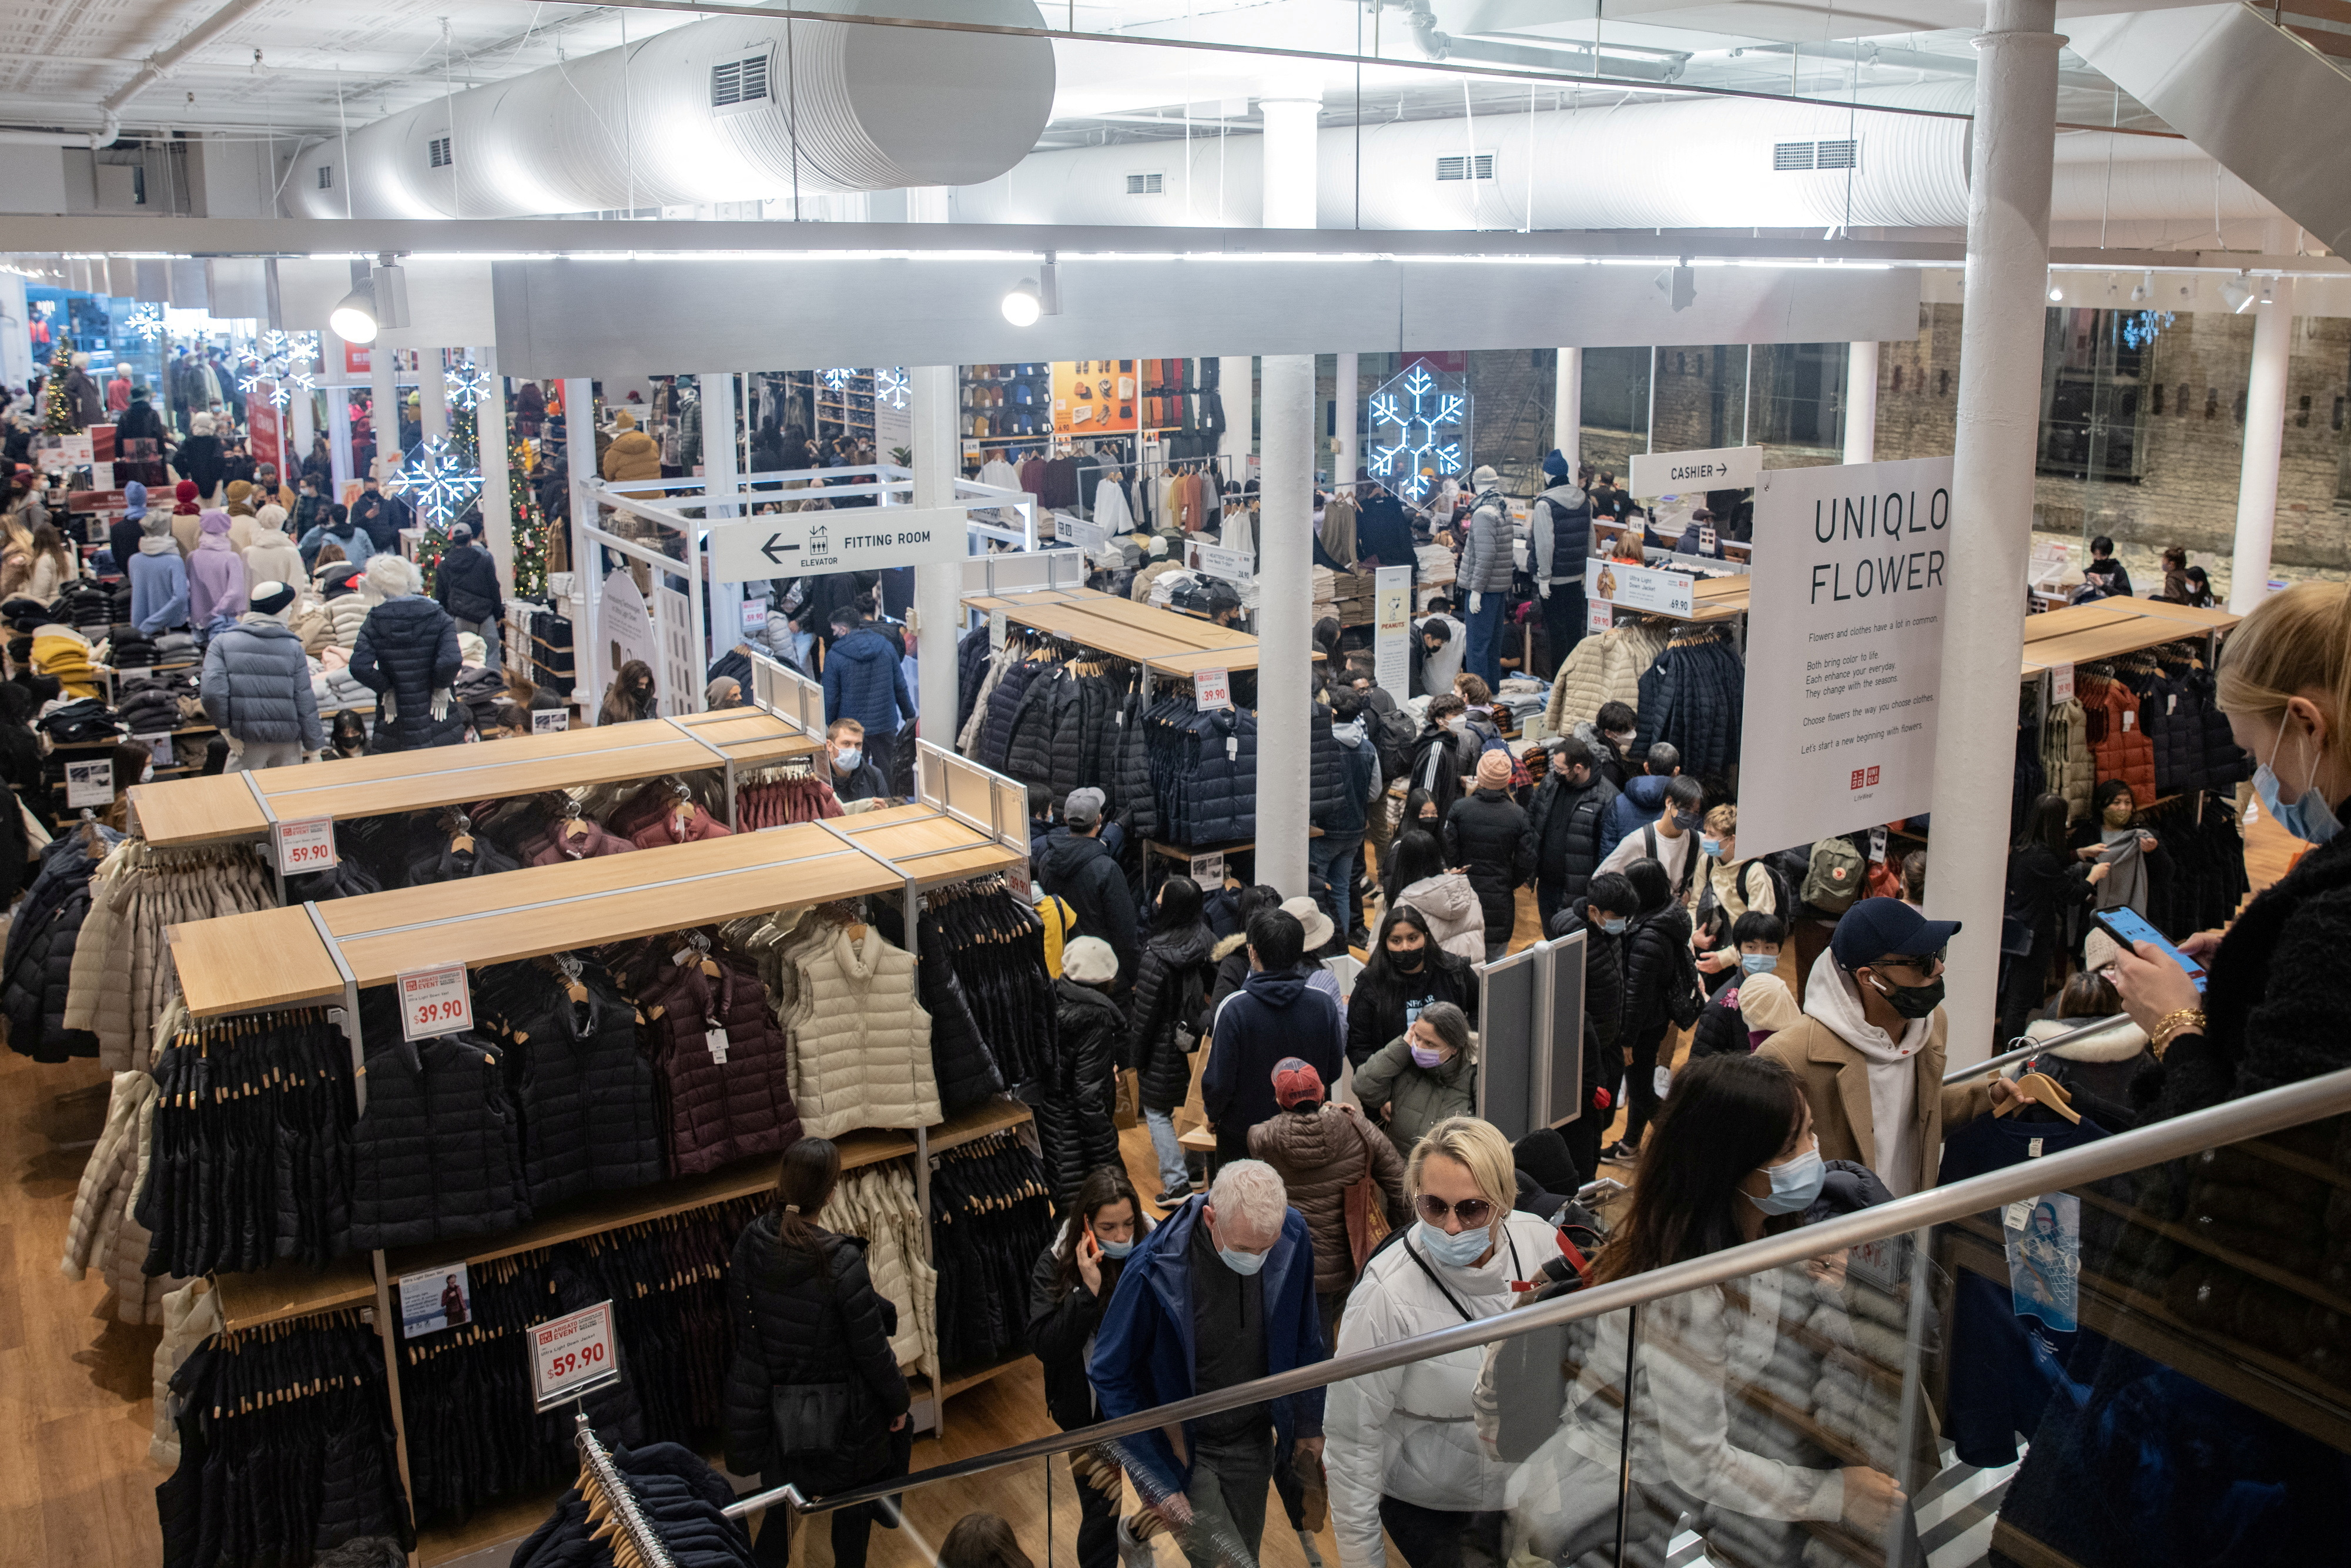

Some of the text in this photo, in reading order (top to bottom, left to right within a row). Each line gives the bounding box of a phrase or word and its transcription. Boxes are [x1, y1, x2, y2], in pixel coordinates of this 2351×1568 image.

[1672, 464, 1713, 480] CASHIER
[1814, 488, 1949, 544] UNIQLO
[845, 531, 931, 550] FITTING ROOM
[801, 557, 838, 567] ELEVATOR
[1810, 550, 1945, 604] FLOWER
[1809, 632, 1834, 642] Flowers
[1836, 628, 1848, 638] and
[1850, 625, 1871, 636] clothes
[1874, 623, 1887, 632] have
[1905, 619, 1910, 627] in
[1913, 616, 1938, 626] common.
[1807, 651, 1879, 671] Both bring color to life.
[1806, 662, 1896, 685] Each enhance your everyday.
[1806, 675, 1898, 699] They change with the seasons.
[1803, 693, 1934, 726] Choose flowers the way you choose clothes.
[1801, 743, 1816, 754] Let's
[1818, 739, 1833, 751] start
[1842, 736, 1854, 746] new
[1857, 730, 1884, 743] beginning
[1887, 726, 1899, 736] with
[1901, 722, 1923, 733] flowers.
[289, 845, 328, 862] $59.90
[418, 981, 438, 990] EVENT
[413, 1000, 462, 1024] $39.90
[554, 1321, 578, 1334] ARIGATO
[554, 1326, 578, 1340] EVENT
[580, 1322, 597, 1331] WEEKEND
[554, 1344, 565, 1352] Light
[581, 1334, 595, 1342] Jacket
[547, 1342, 604, 1379] $59.90
